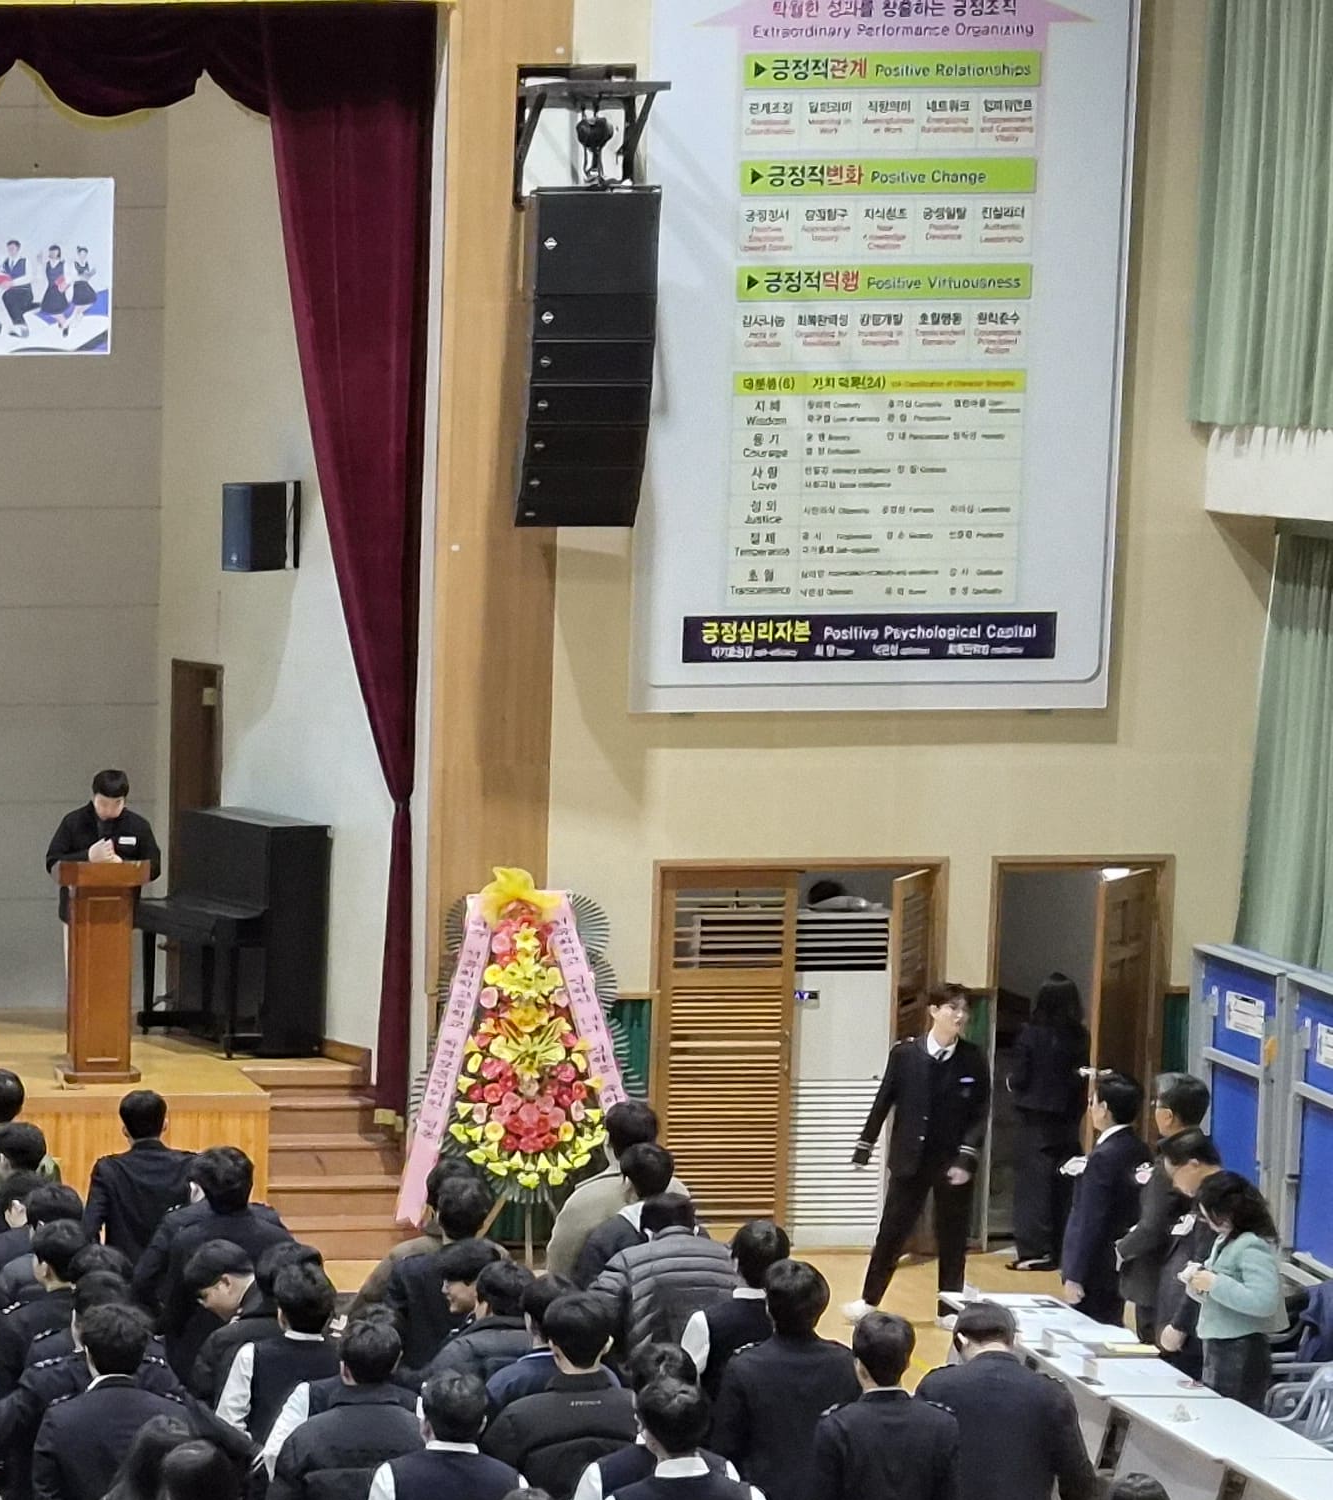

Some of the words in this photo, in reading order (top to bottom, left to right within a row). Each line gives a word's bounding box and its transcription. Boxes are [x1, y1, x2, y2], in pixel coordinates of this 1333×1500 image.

[773, 0, 819, 18] 탁월한
[827, 0, 873, 18] 성과를
[882, 0, 946, 18] 창출하는
[953, 0, 1017, 18] 긍정조직
[753, 24, 851, 39] Extraordinary
[857, 23, 950, 37] Performance
[955, 22, 1034, 37] Organizing
[772, 58, 868, 81] 긍정적관계
[875, 64, 931, 78] Positive
[935, 62, 1031, 78] Relationships
[768, 163, 864, 187] 긍정적변화
[871, 168, 927, 186] Positive
[931, 168, 987, 186] Change
[763, 269, 860, 293] 긍정적덕행
[867, 274, 922, 292] Positive
[928, 273, 1021, 291] Virtuousness
[747, 416, 787, 425] Wisdom
[743, 448, 788, 458] Courage
[751, 479, 778, 491] Love
[745, 515, 783, 524] Justice
[701, 620, 812, 644] 긍정심리자본
[823, 626, 879, 641] Positive
[884, 625, 981, 640] Psychological
[986, 624, 1036, 638] Capital
